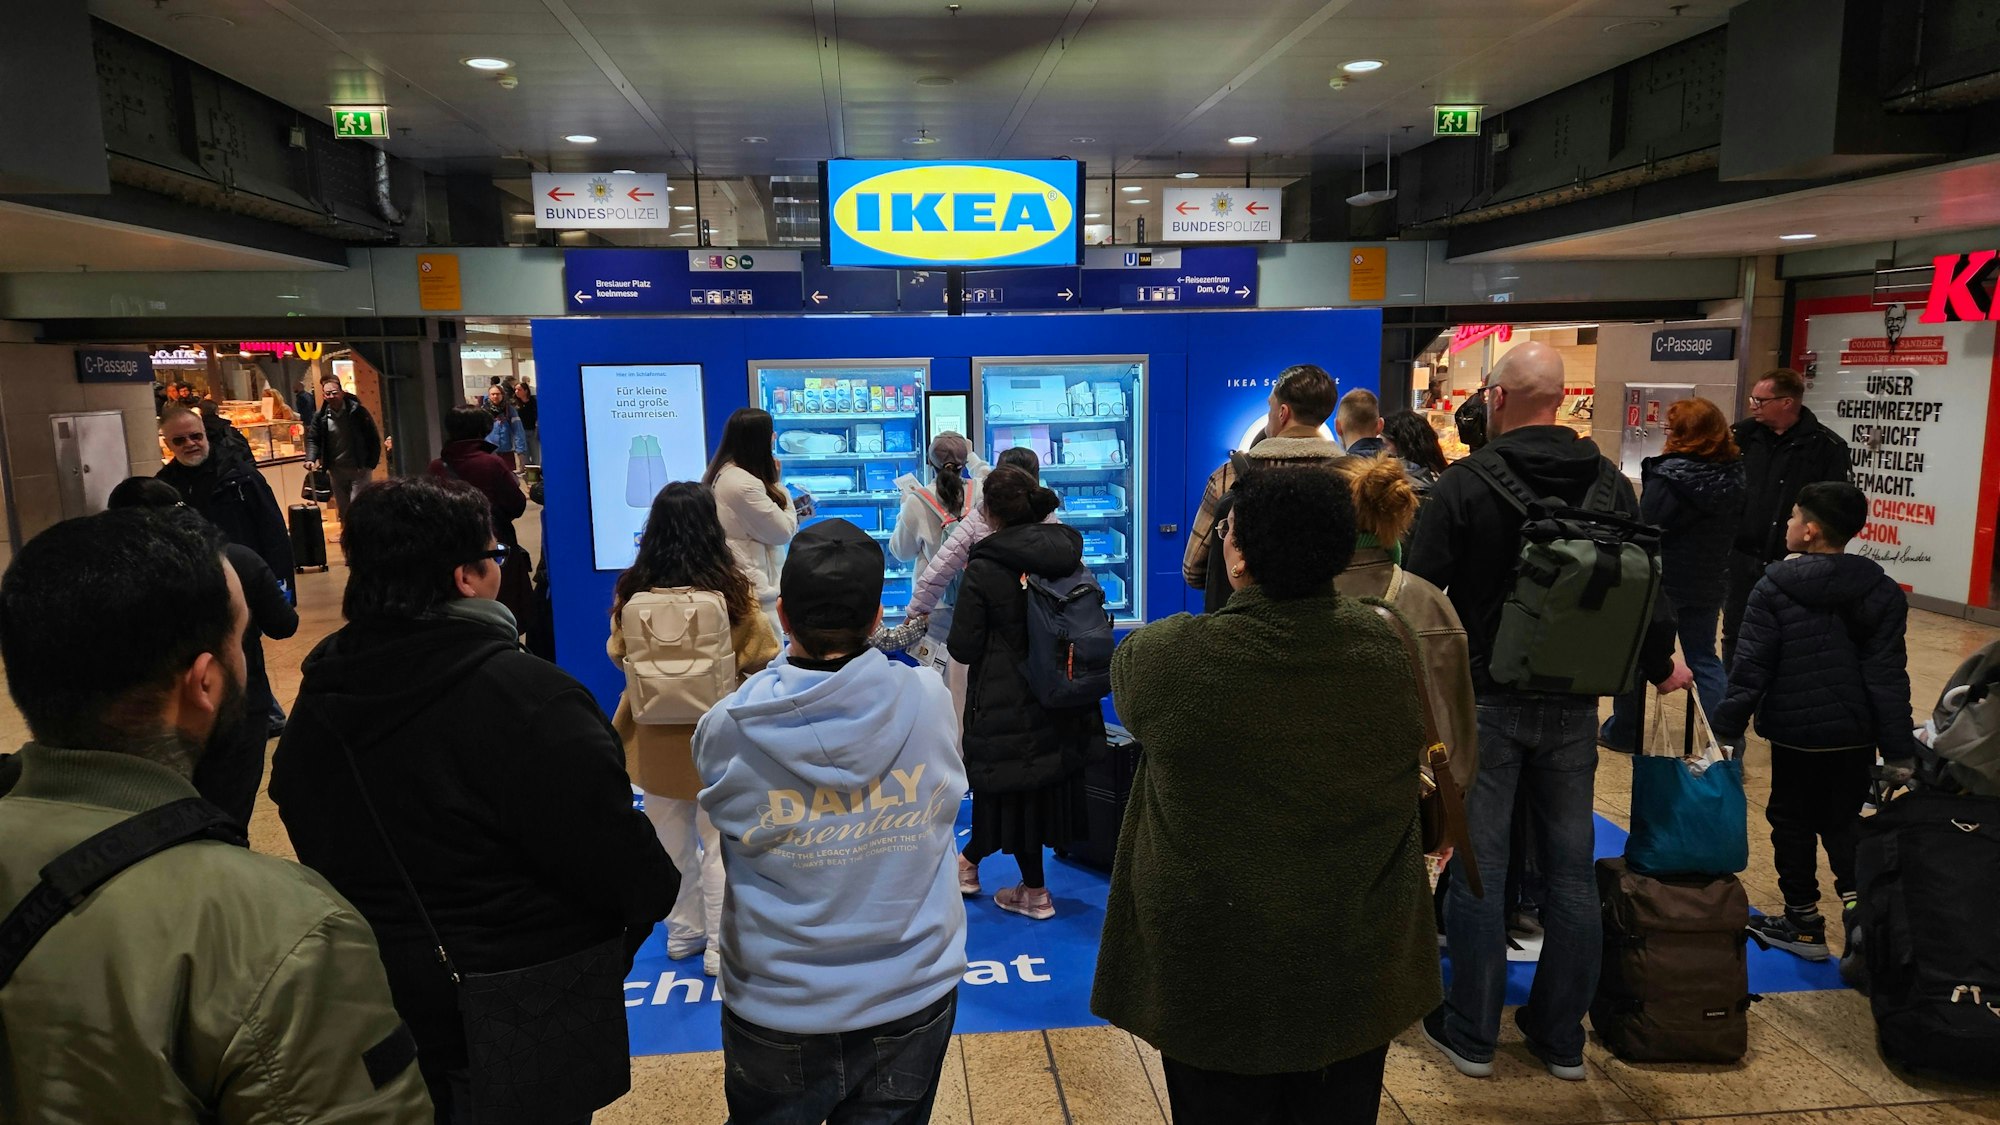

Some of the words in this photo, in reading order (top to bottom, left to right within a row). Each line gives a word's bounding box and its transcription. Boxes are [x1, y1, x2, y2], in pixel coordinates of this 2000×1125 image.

[545, 208, 659, 220] BUNDESPOLIZEI
[856, 193, 1056, 231] IKEA
[1172, 221, 1271, 232] BUNDESPOLIZEI
[725, 255, 737, 269] S
[1126, 253, 1136, 266] U
[596, 280, 630, 288] Breslauer
[632, 280, 651, 288] Platz
[1185, 276, 1230, 284] Reisezentrum
[597, 289, 639, 298] koelnmesse
[1197, 285, 1215, 294] Dom,
[1216, 285, 1230, 294] City
[1655, 336, 1713, 355] C-Passage
[84, 356, 139, 376] C-Passage
[616, 386, 634, 395] Für
[636, 386, 667, 395] kleine
[1227, 378, 1257, 387] IKEA
[1866, 376, 1913, 395] UNSER
[616, 398, 636, 407] und
[639, 397, 669, 409] große
[1837, 400, 1942, 422] GEHEIMREZEPT
[611, 409, 678, 419] Traumreisen.
[1849, 448, 1873, 468] UM
[1876, 449, 1924, 472] TEILEN
[1873, 498, 1936, 525] CHICKEN
[1854, 521, 1901, 545] CHON.
[768, 763, 926, 826] DAILY
[741, 772, 950, 847] Essentials
[816, 847, 850, 857] LEGACY
[852, 843, 868, 855] AND
[869, 836, 898, 847] INVENT
[901, 834, 917, 842] THE
[826, 858, 847, 866] BEAT
[865, 844, 918, 857] COMPETITION
